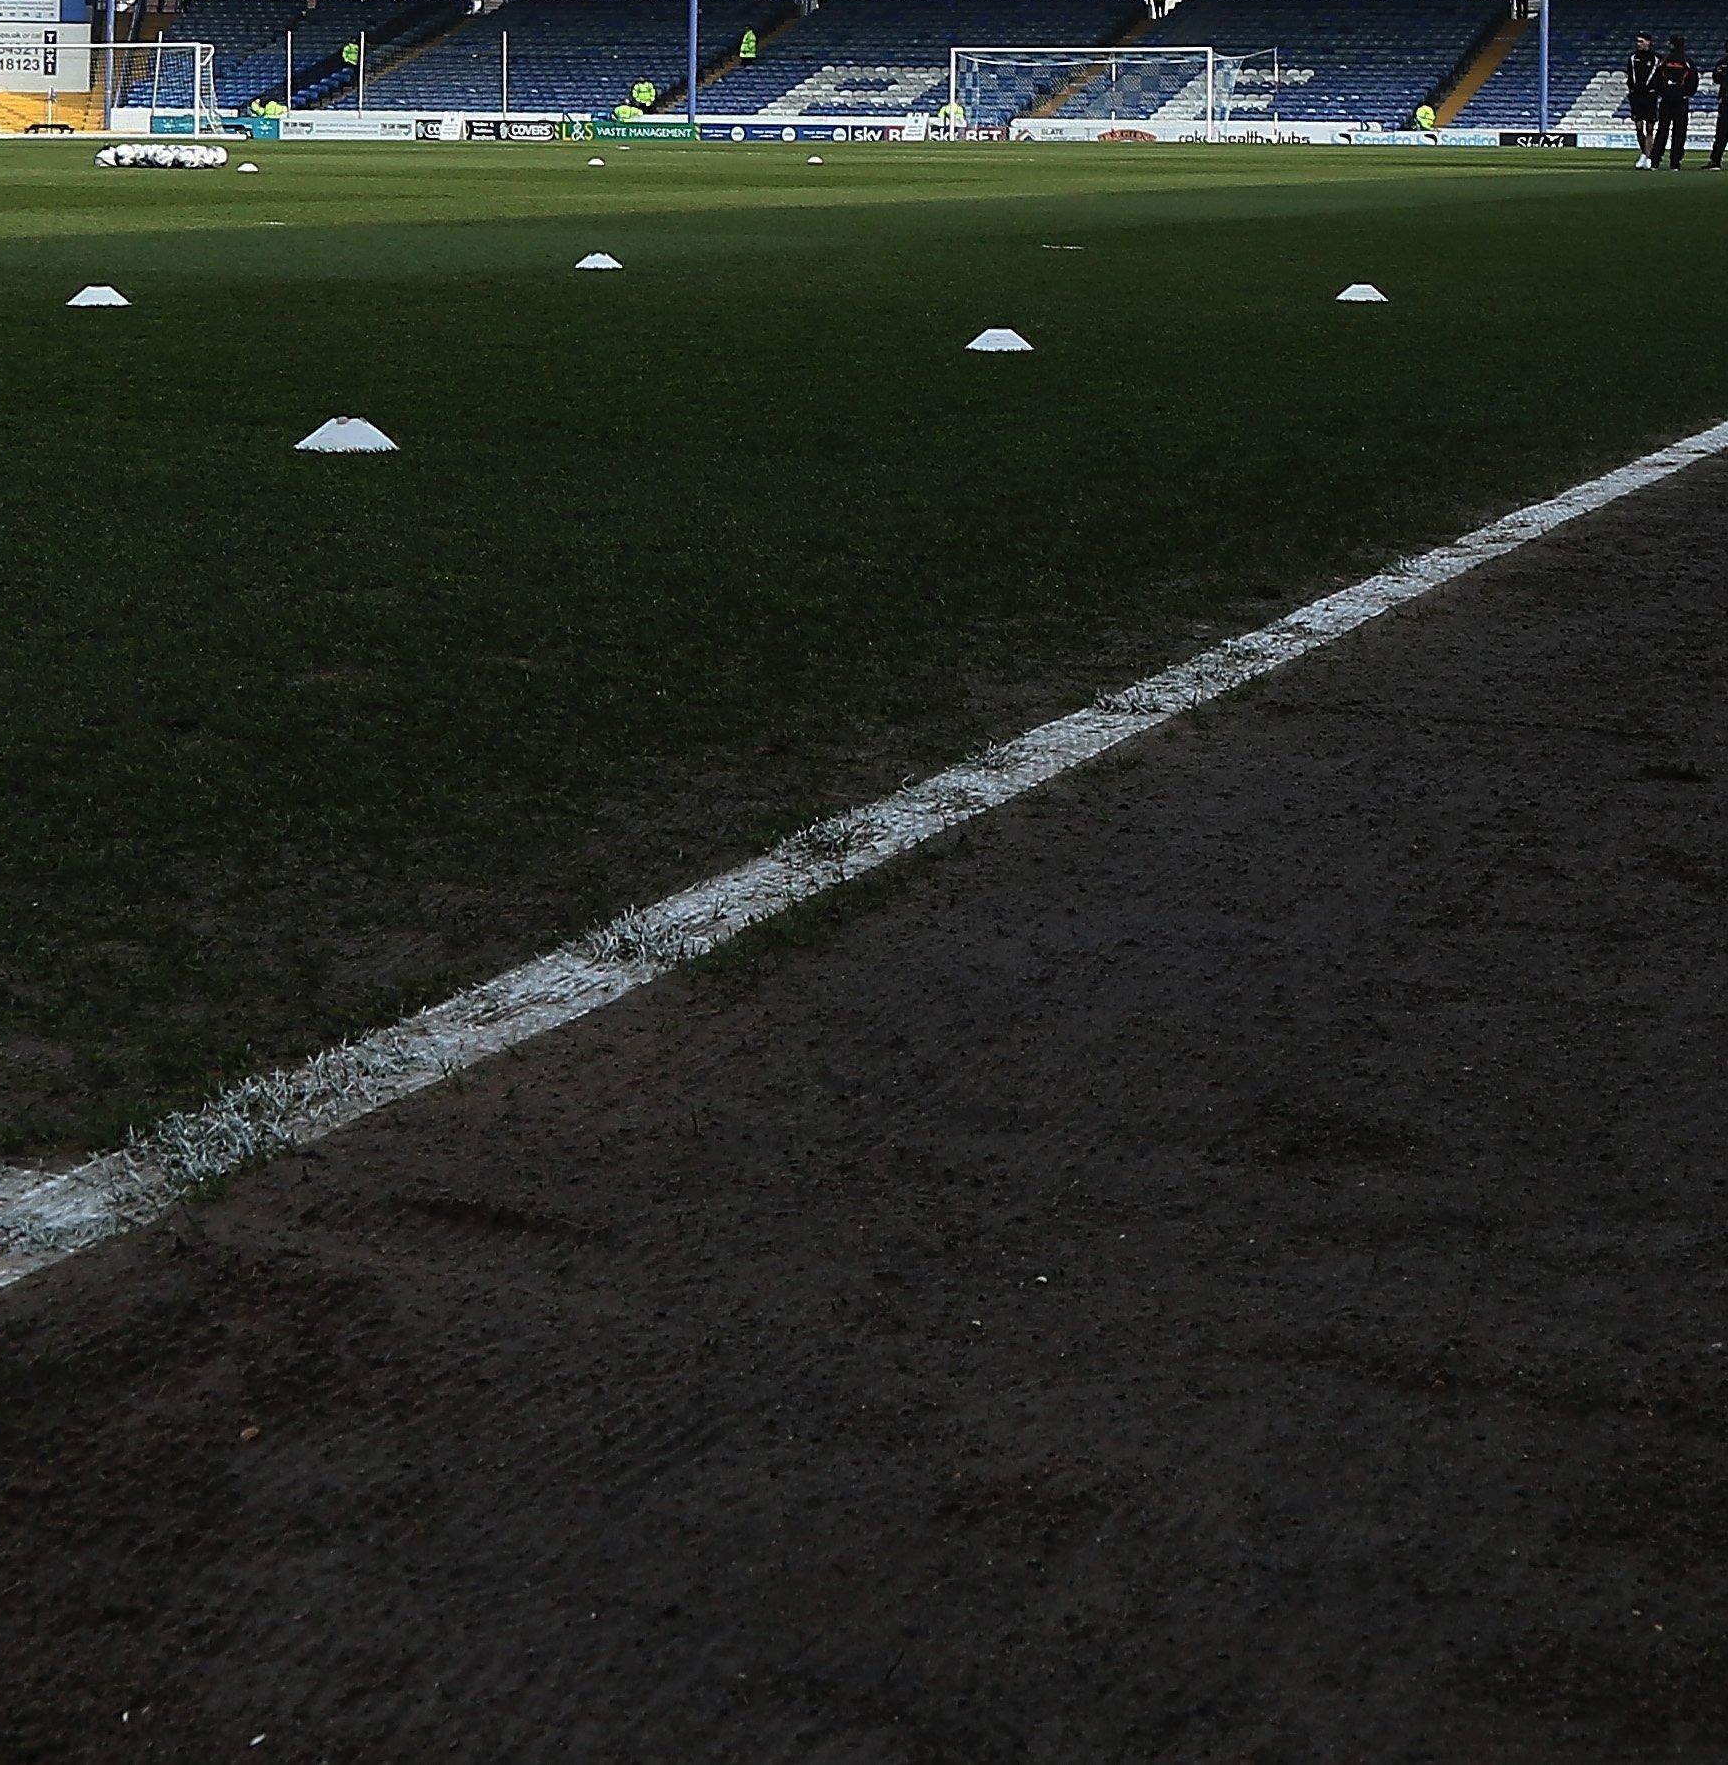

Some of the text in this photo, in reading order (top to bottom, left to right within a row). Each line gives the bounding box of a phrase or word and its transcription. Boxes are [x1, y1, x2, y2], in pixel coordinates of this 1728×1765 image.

[511, 125, 551, 136] COVERS
[562, 121, 594, 141] L&S
[596, 127, 628, 137] WASTE
[629, 127, 693, 138] MANAGEMENT
[1354, 134, 1413, 144] Sondico
[1441, 134, 1498, 146] Sondico
